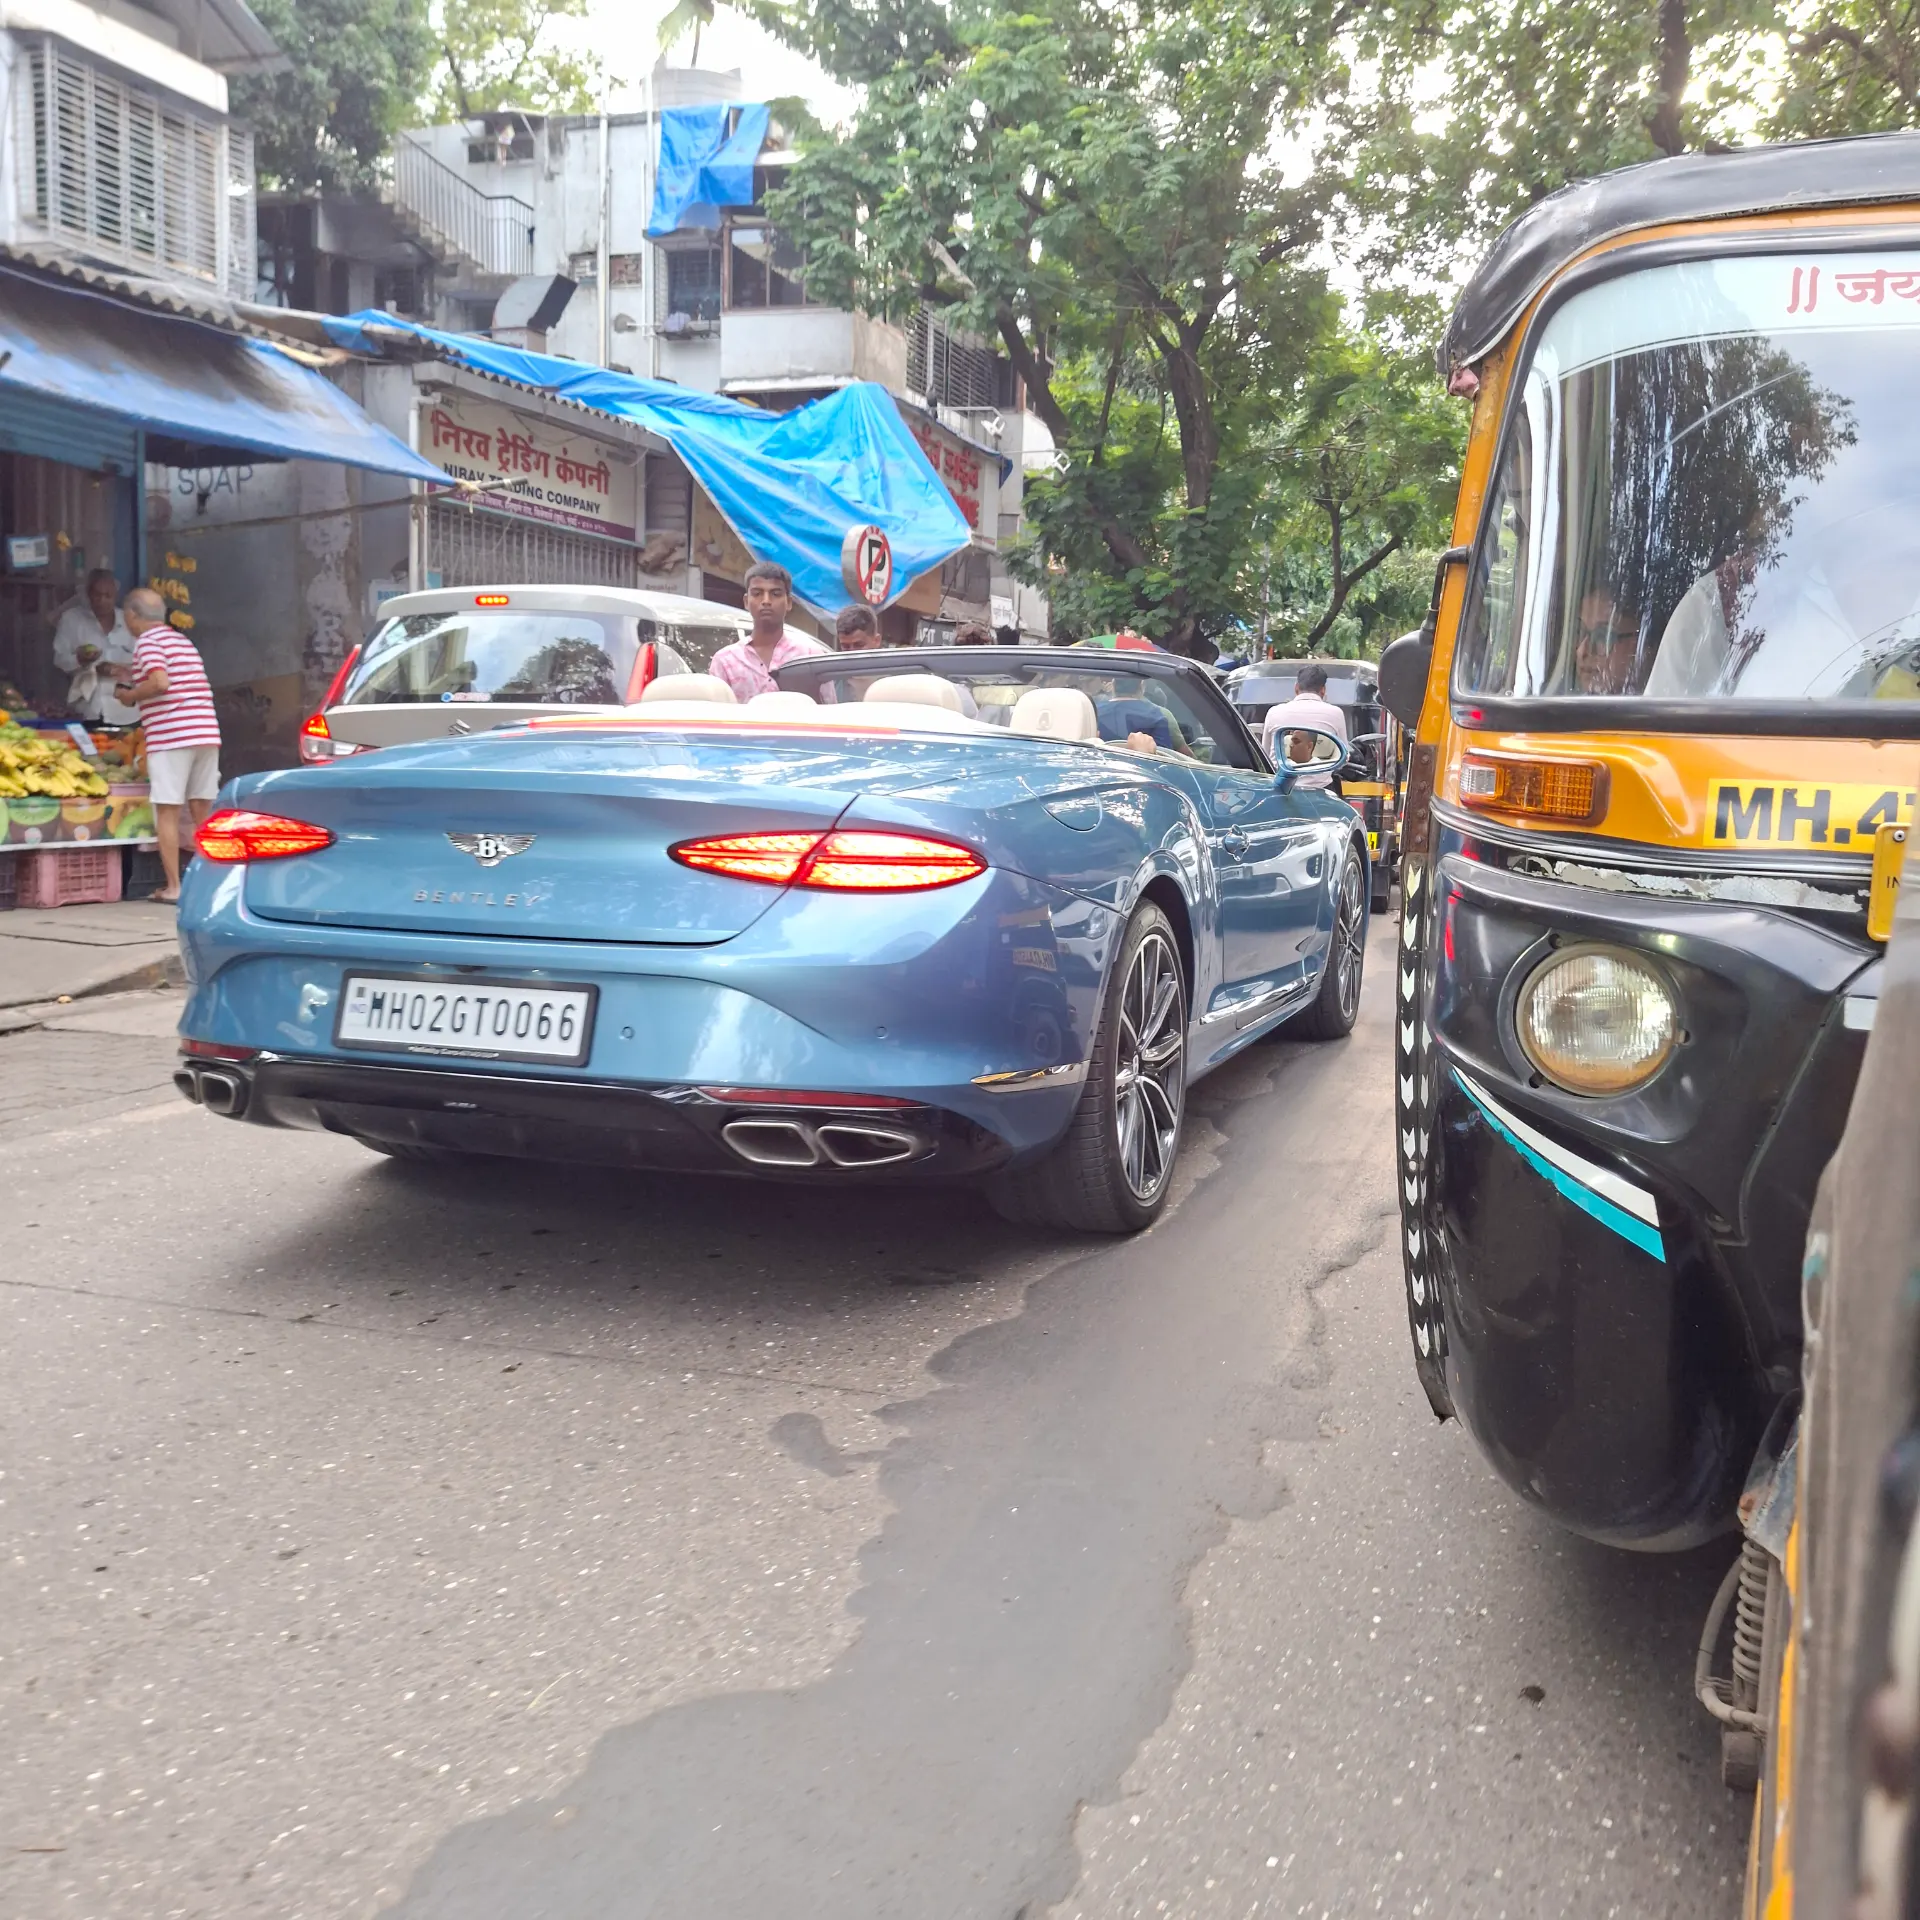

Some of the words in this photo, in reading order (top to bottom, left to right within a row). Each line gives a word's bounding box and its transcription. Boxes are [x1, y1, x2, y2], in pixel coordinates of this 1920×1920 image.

[431, 409, 492, 462] निरव
[496, 426, 551, 477] ट्रेडिंग
[555, 447, 611, 495] कंपनी
[178, 466, 254, 495] SOAP
[547, 490, 601, 514] COMPANY
[413, 889, 541, 908] BENTLEY
[367, 990, 577, 1041] MH02GT0066
